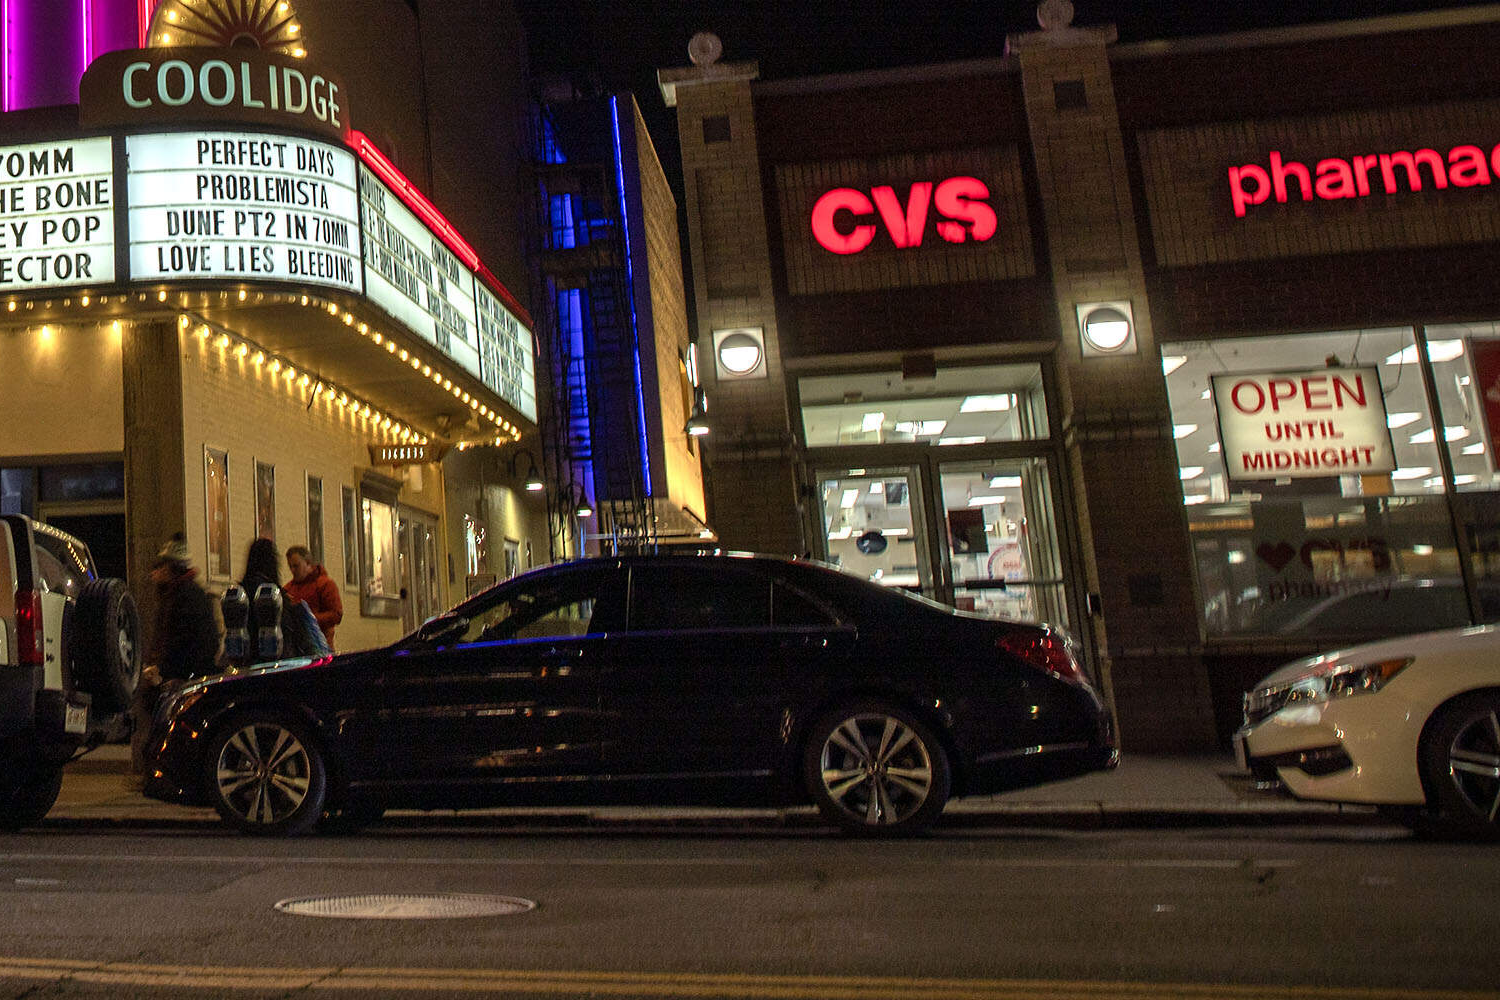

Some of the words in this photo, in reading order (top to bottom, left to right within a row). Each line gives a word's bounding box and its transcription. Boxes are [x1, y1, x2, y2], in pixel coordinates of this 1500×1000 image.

[122, 60, 341, 128] COOLIDGE
[197, 139, 287, 168] PERFECT
[296, 147, 335, 177] DAYS
[36, 179, 110, 211] BONE
[197, 174, 329, 210] PROBLEMISTA
[1228, 142, 1500, 217] pharma
[42, 215, 101, 245] POP
[167, 210, 225, 237] DUNE
[235, 211, 277, 238] PT2
[286, 214, 308, 241] IN
[313, 217, 349, 249] 70MM
[811, 176, 997, 255] CVS
[158, 246, 212, 273] LOVE
[224, 246, 275, 273] LIES
[288, 249, 354, 285] BLEEDING
[1231, 374, 1367, 416] OPEN
[1265, 419, 1343, 443] UNTIL
[1242, 444, 1375, 471] MIDNIGHT
